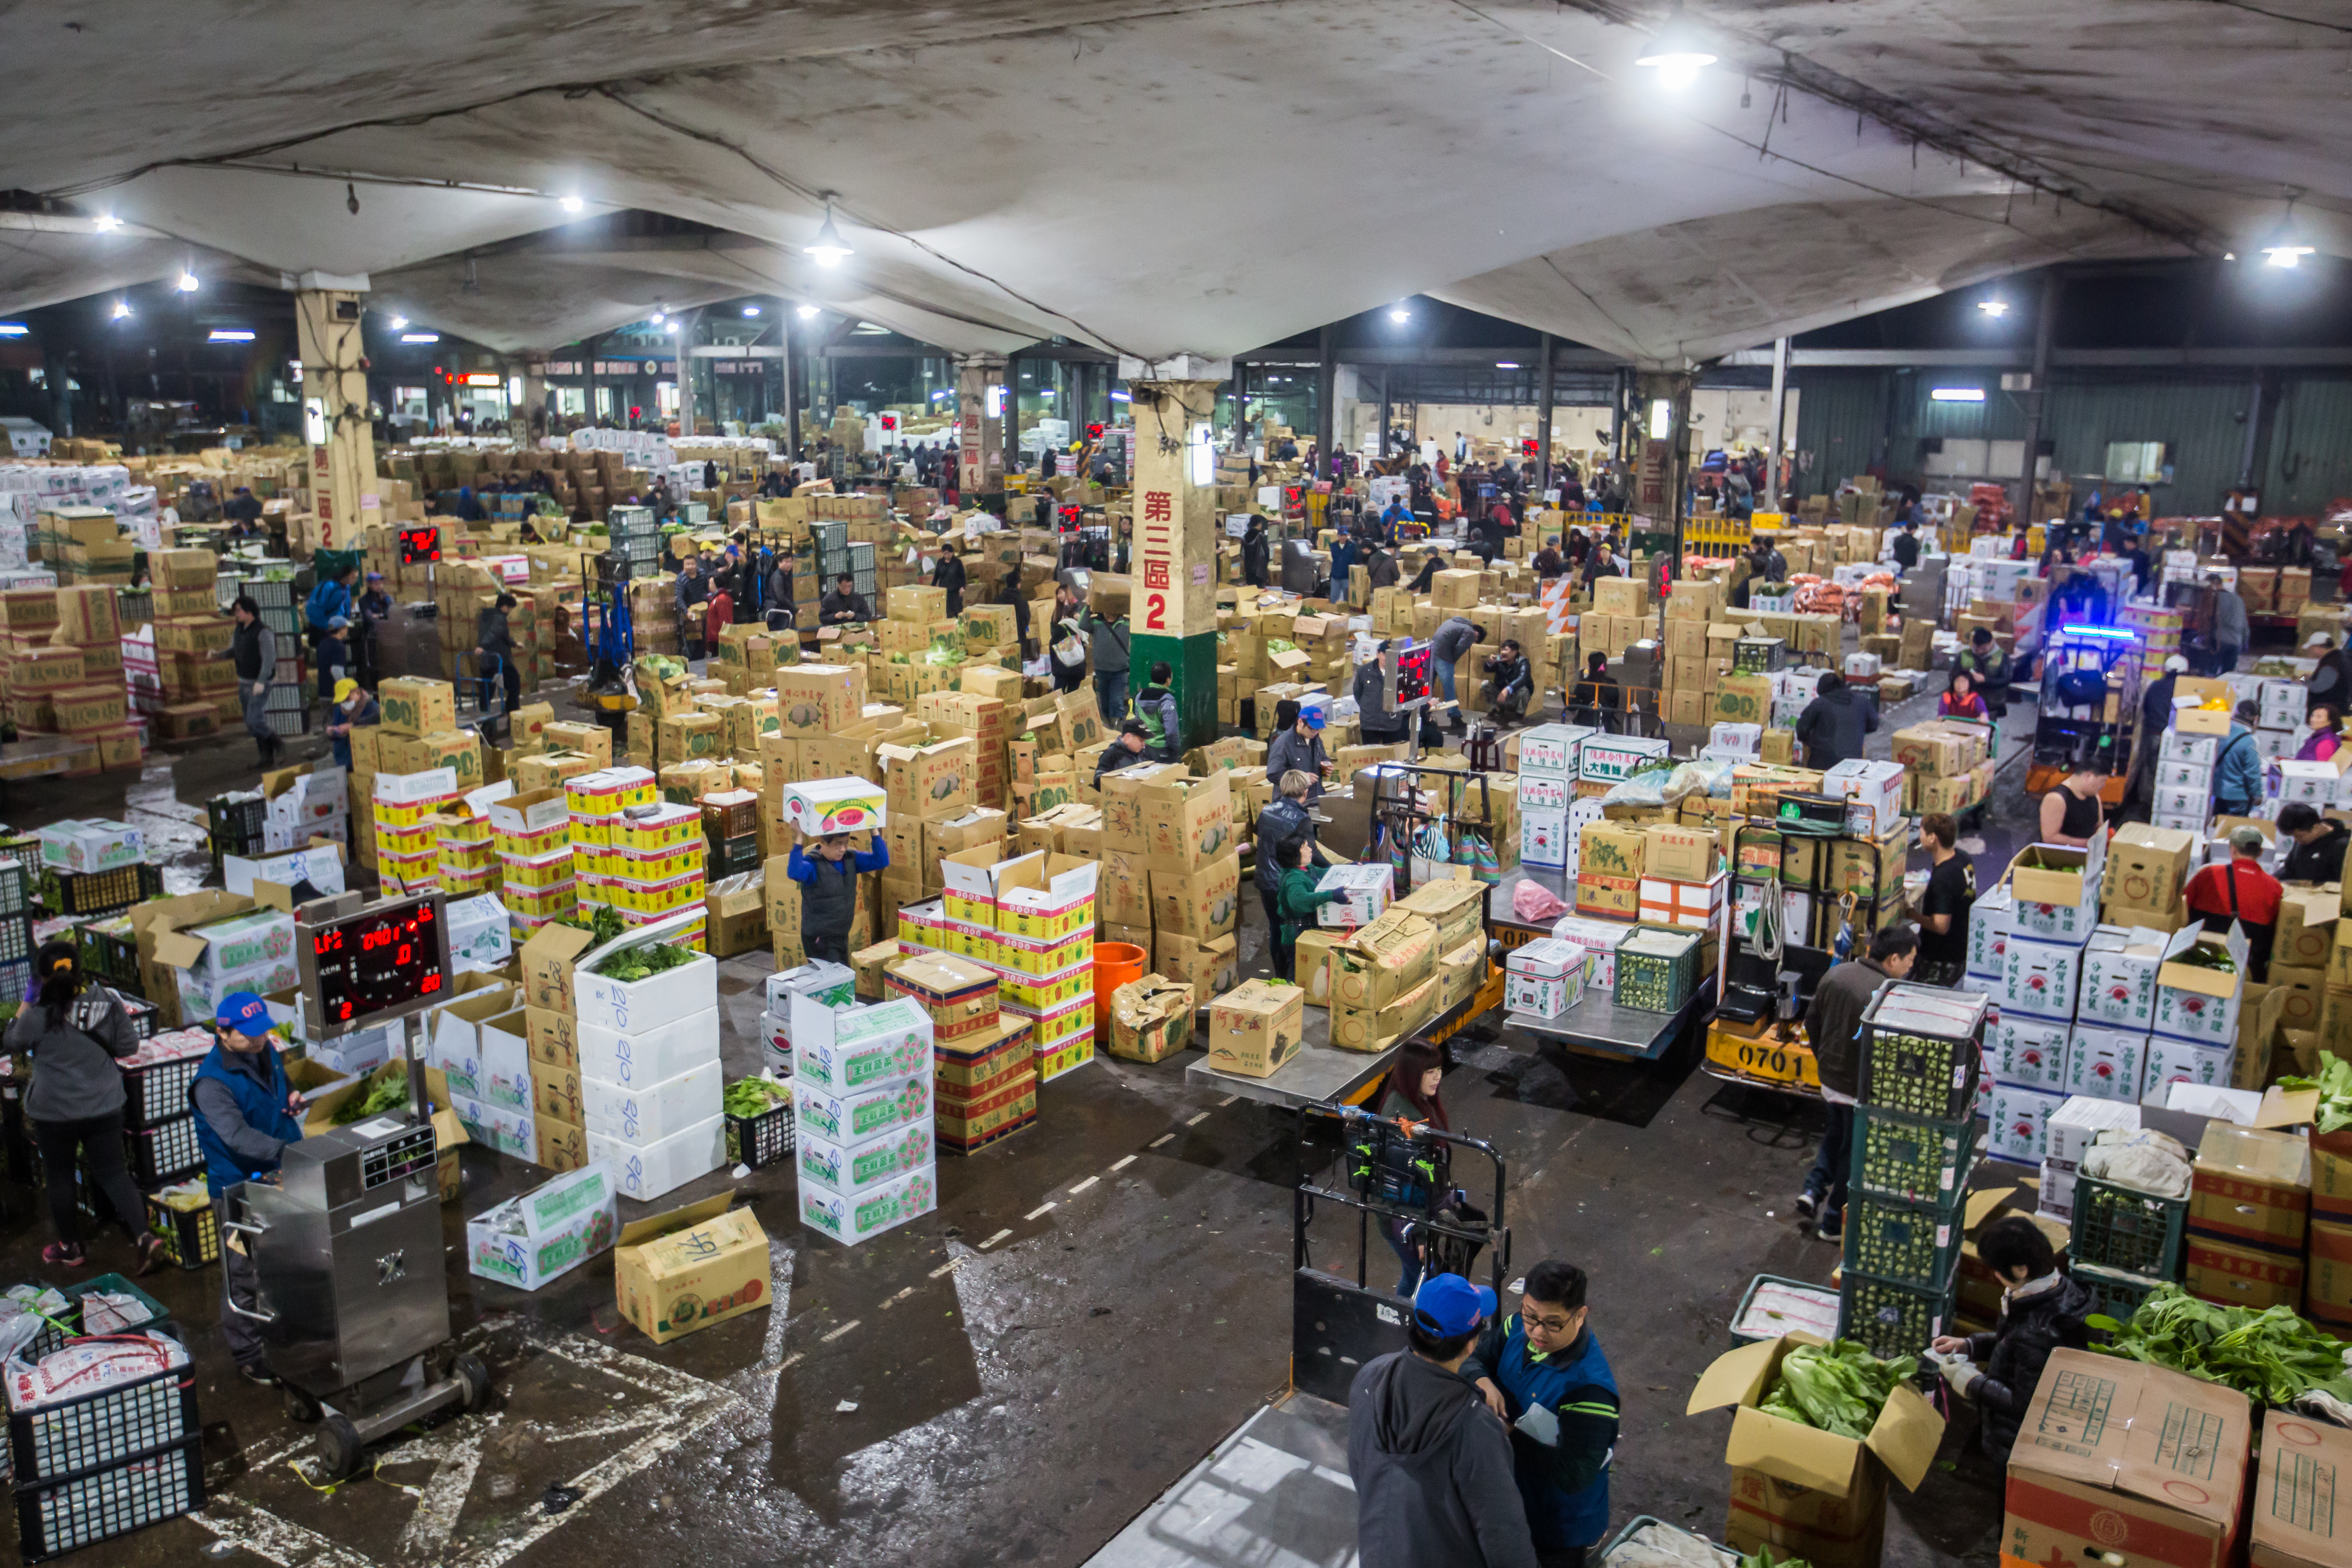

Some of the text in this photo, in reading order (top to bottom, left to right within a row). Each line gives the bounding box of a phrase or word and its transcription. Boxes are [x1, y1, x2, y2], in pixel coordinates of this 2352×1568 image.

[322, 522, 332, 547] 2
[1144, 491, 1172, 590] 第三區
[1146, 593, 1165, 630] 2
[341, 1002, 352, 1019] 2
[1739, 1045, 1802, 1077] 0701
